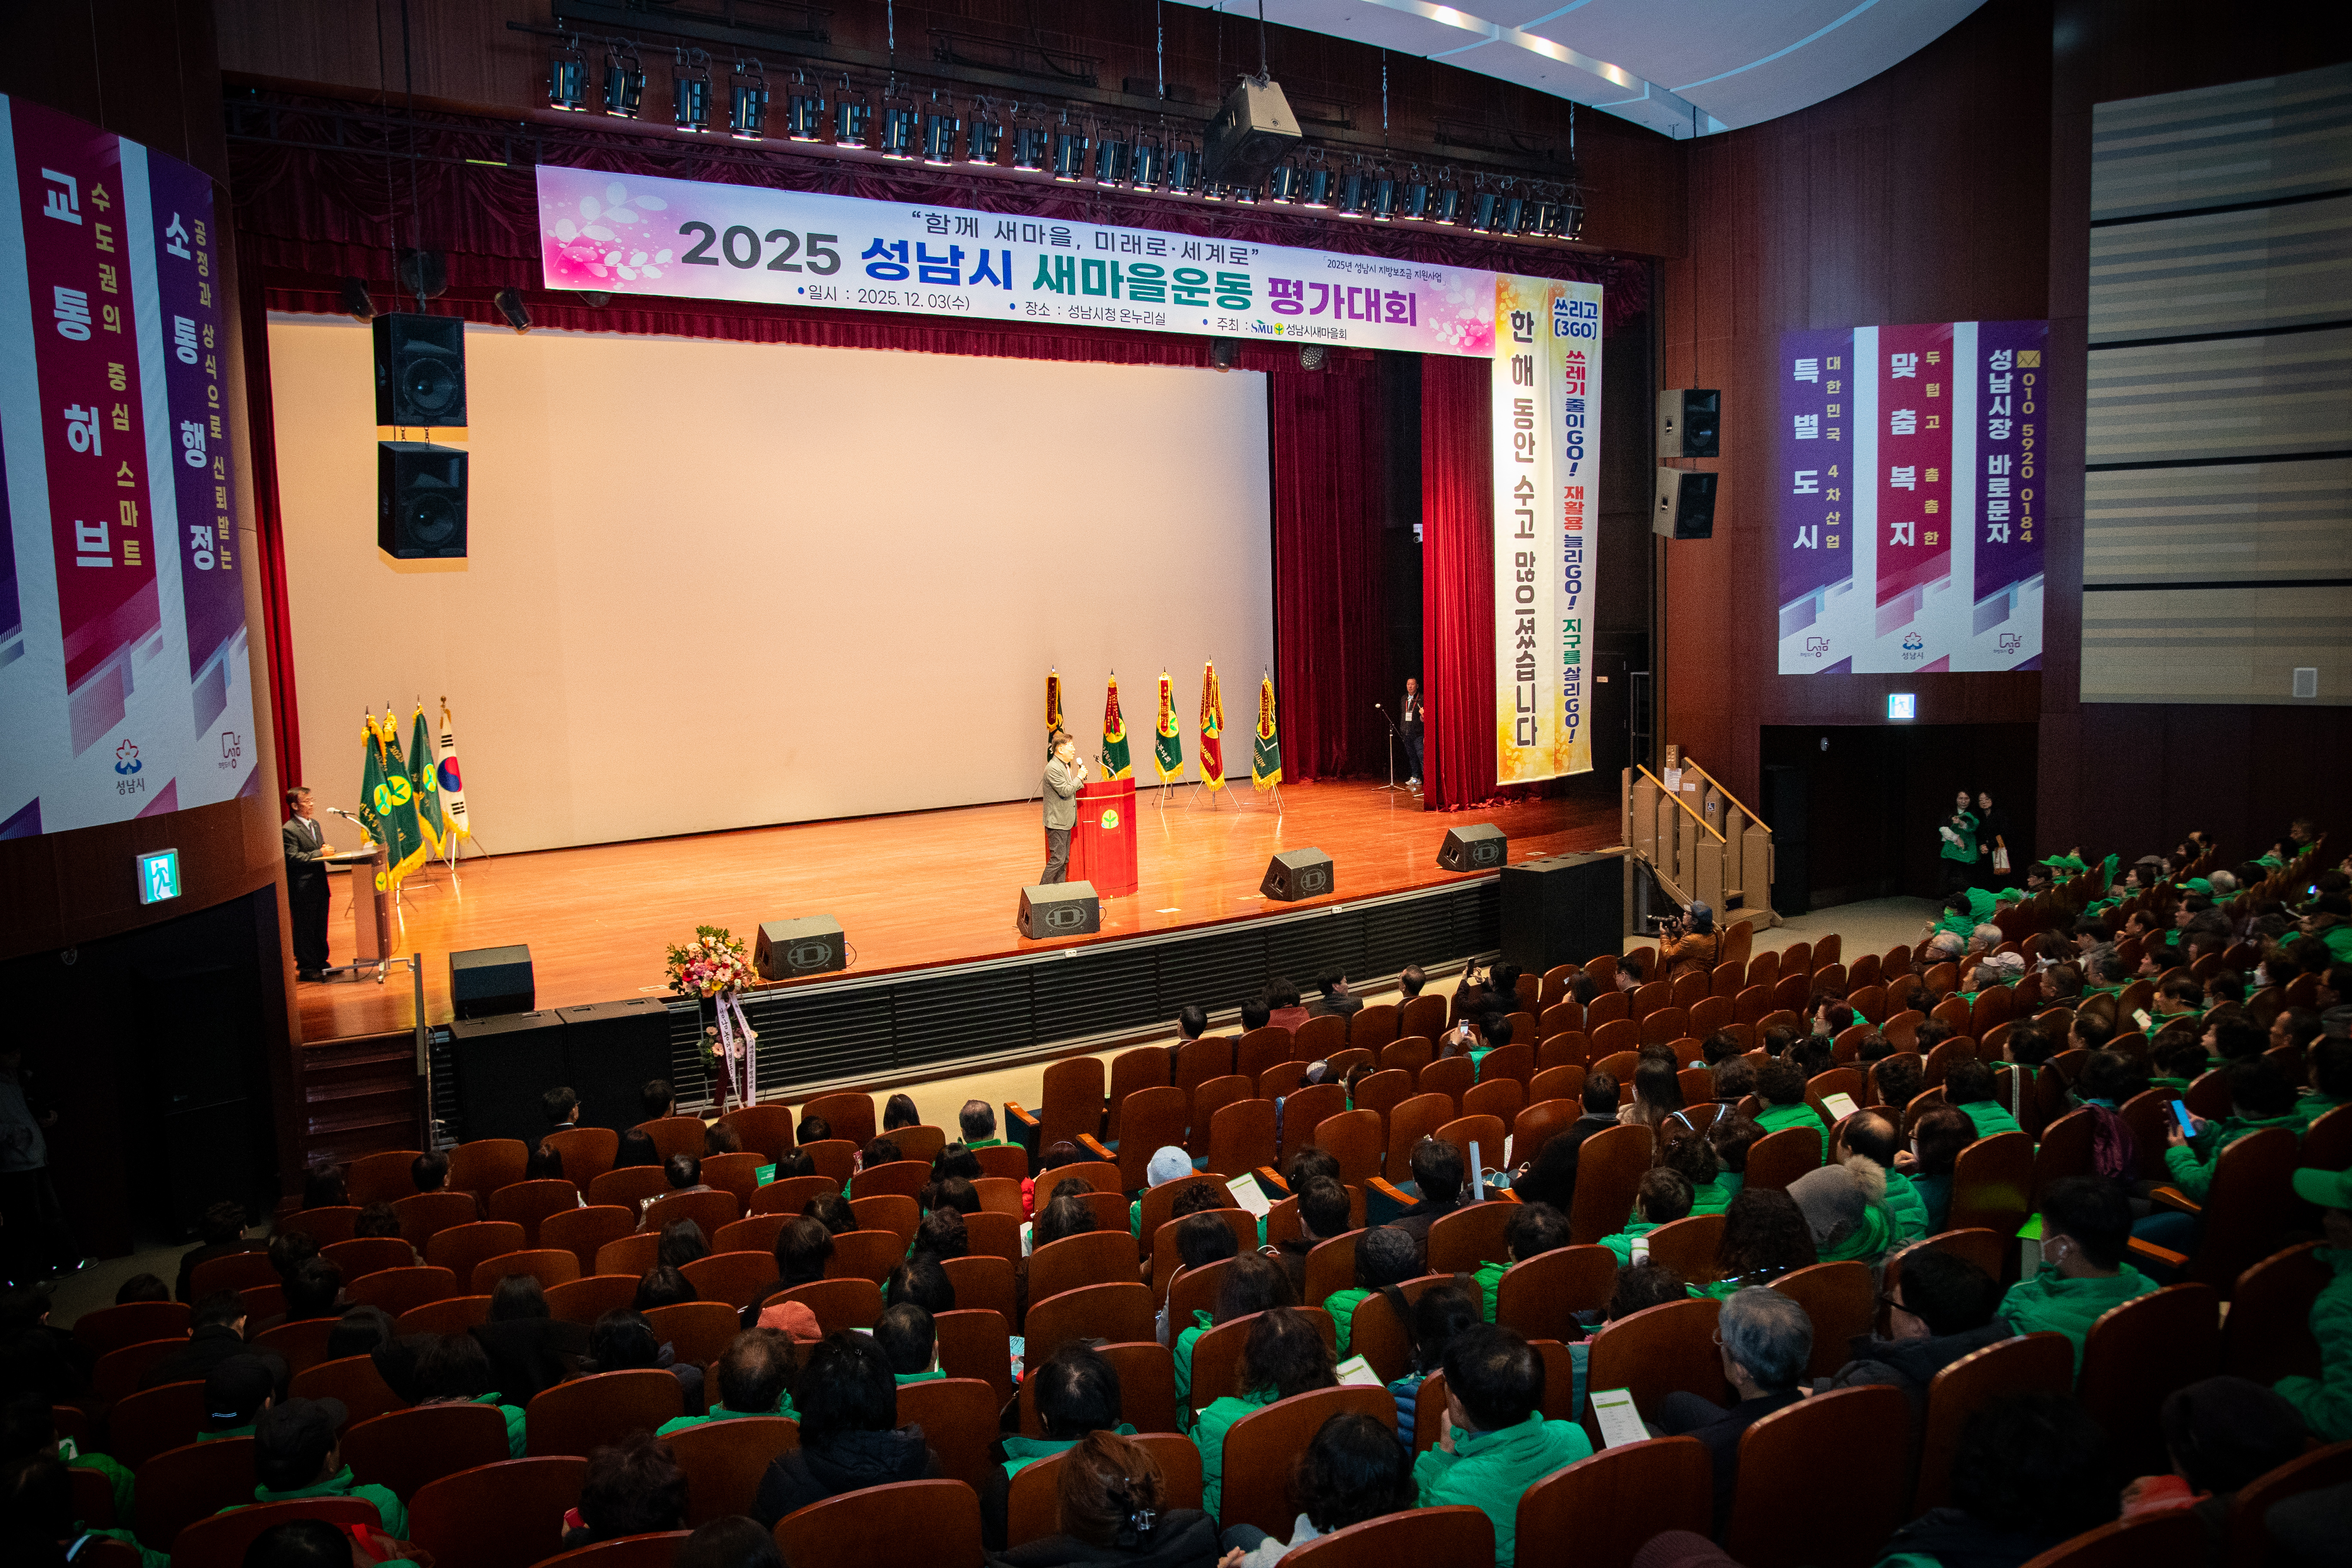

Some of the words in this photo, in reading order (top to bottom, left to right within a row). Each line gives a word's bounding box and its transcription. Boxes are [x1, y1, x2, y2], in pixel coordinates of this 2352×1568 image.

[91, 183, 122, 334] 수도권의
[994, 220, 1081, 251] 새마을,
[679, 221, 841, 276] 2025
[861, 237, 1012, 291] 성남시
[1033, 254, 1253, 310] 새마을운동
[1268, 277, 1417, 327] 평가대회
[808, 285, 837, 301] 일시
[858, 288, 900, 306] 2025.
[904, 292, 924, 307] 12.
[928, 294, 970, 311] 03(수)
[1354, 263, 1376, 274] 성남시
[1378, 266, 1412, 279] 지방보조금
[1026, 302, 1050, 316] 장소
[1068, 305, 1116, 322] 성남시청
[1120, 309, 1166, 325] 온누리실
[1217, 317, 1238, 331] 주최
[1510, 310, 1534, 343] 한
[1554, 299, 1598, 319] 쓰리고
[41, 167, 113, 568] 교통허브
[107, 361, 130, 432] 중심
[165, 211, 215, 570] 소통행정
[194, 219, 211, 308] 공정과
[213, 456, 232, 570] 신뢰받는
[1511, 354, 1534, 386] 해
[1826, 356, 1841, 441] 대한민국
[1988, 349, 2013, 440] 성남시장
[2022, 374, 2036, 414] 010
[1513, 398, 1536, 463] 동안
[1793, 358, 1819, 549] 특별도시
[1890, 353, 1918, 547] 맞춤복지
[2021, 424, 2035, 479] 5920
[116, 461, 142, 566] 스마트
[1514, 475, 1535, 539] 수고
[1825, 465, 1841, 549] 4차산업
[1923, 468, 1939, 545] 촘촘한
[1986, 454, 2012, 544] 바로문자
[2020, 488, 2034, 543] 0184
[1515, 551, 1537, 747] 많으셨습니다
[1902, 652, 1924, 660] 성남시
[116, 778, 145, 795] 성남시
